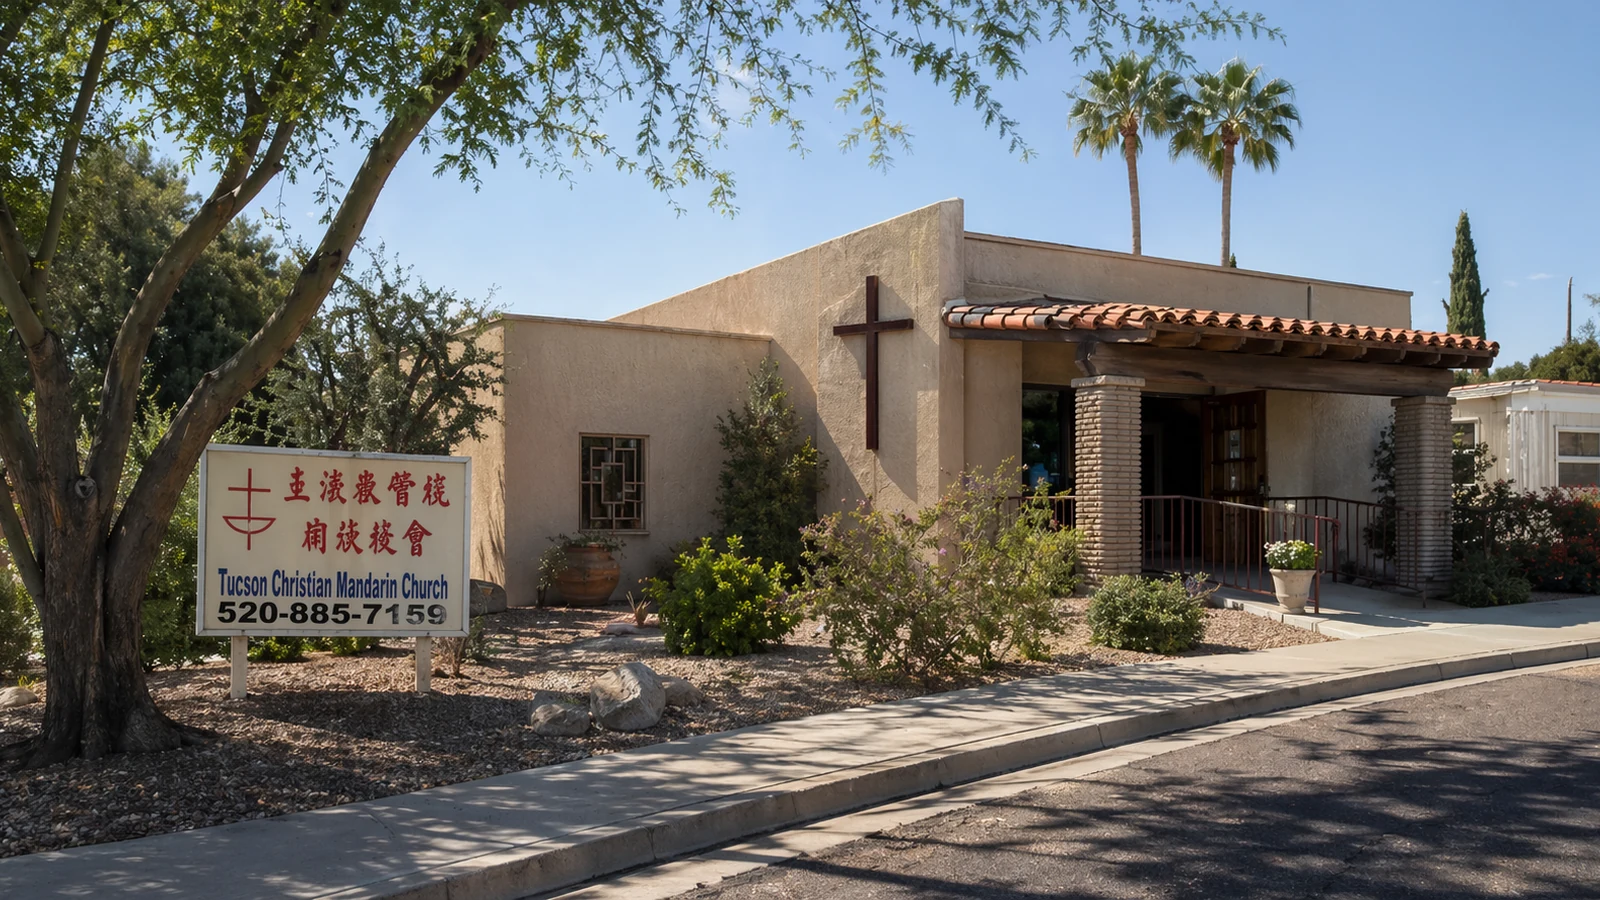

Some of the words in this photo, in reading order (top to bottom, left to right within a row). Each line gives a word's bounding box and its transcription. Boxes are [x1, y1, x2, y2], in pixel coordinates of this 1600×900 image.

[218, 568, 267, 597] Tucson
[272, 569, 332, 598] Christian
[336, 571, 397, 599] Mandarin
[401, 572, 448, 600] Church
[217, 601, 447, 625] 520-885-7159
